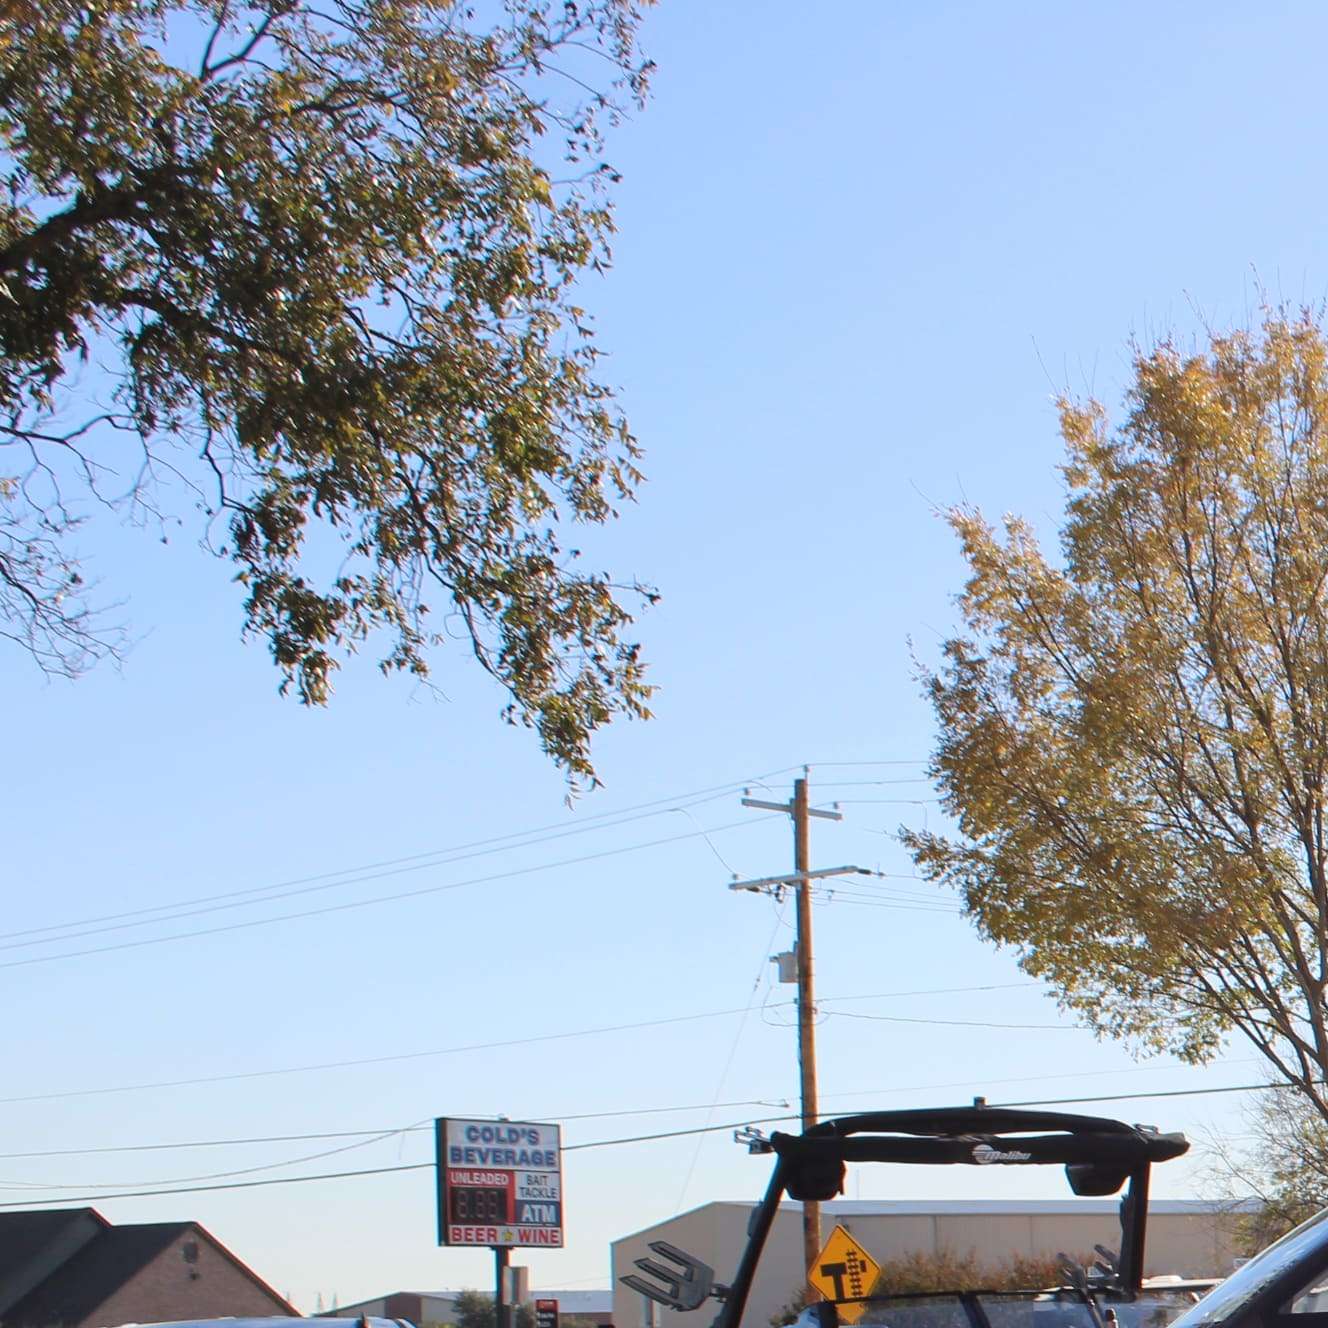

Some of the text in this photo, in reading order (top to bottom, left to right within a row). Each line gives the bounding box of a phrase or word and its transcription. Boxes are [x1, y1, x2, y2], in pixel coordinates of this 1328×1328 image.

[450, 1146, 556, 1168] BEVERAGE
[450, 1171, 509, 1185] UNLEADED
[526, 1174, 549, 1186] BAIT
[520, 1187, 558, 1199] TACKLE
[521, 1204, 556, 1223] ATM
[451, 1228, 560, 1243] BEER WINE
